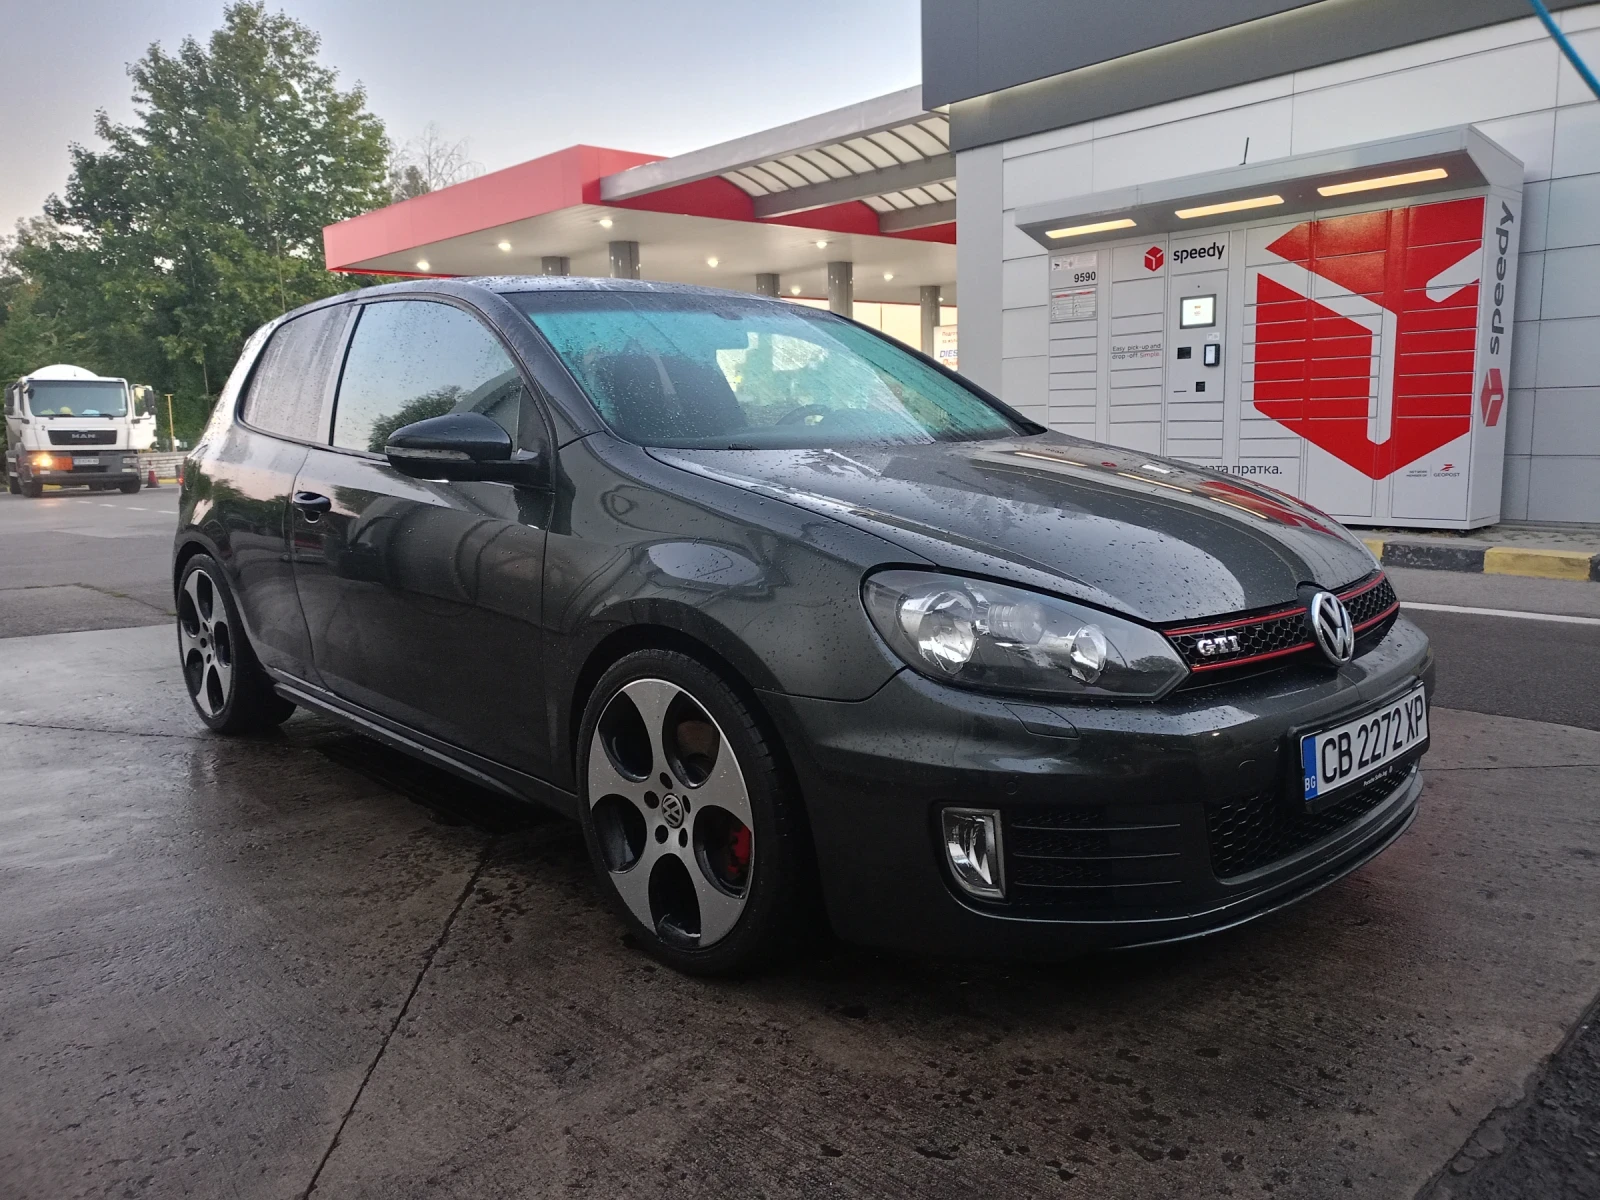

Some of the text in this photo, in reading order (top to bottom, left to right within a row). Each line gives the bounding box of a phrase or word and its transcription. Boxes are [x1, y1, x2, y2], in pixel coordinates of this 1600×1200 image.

[1173, 242, 1226, 264] speedy
[1073, 271, 1097, 283] 9590
[1489, 200, 1515, 356] speedy
[1232, 464, 1283, 476] пратка.
[1196, 635, 1241, 656] GTI
[1321, 694, 1424, 784] CB 2272 XP
[1304, 776, 1317, 791] BG
